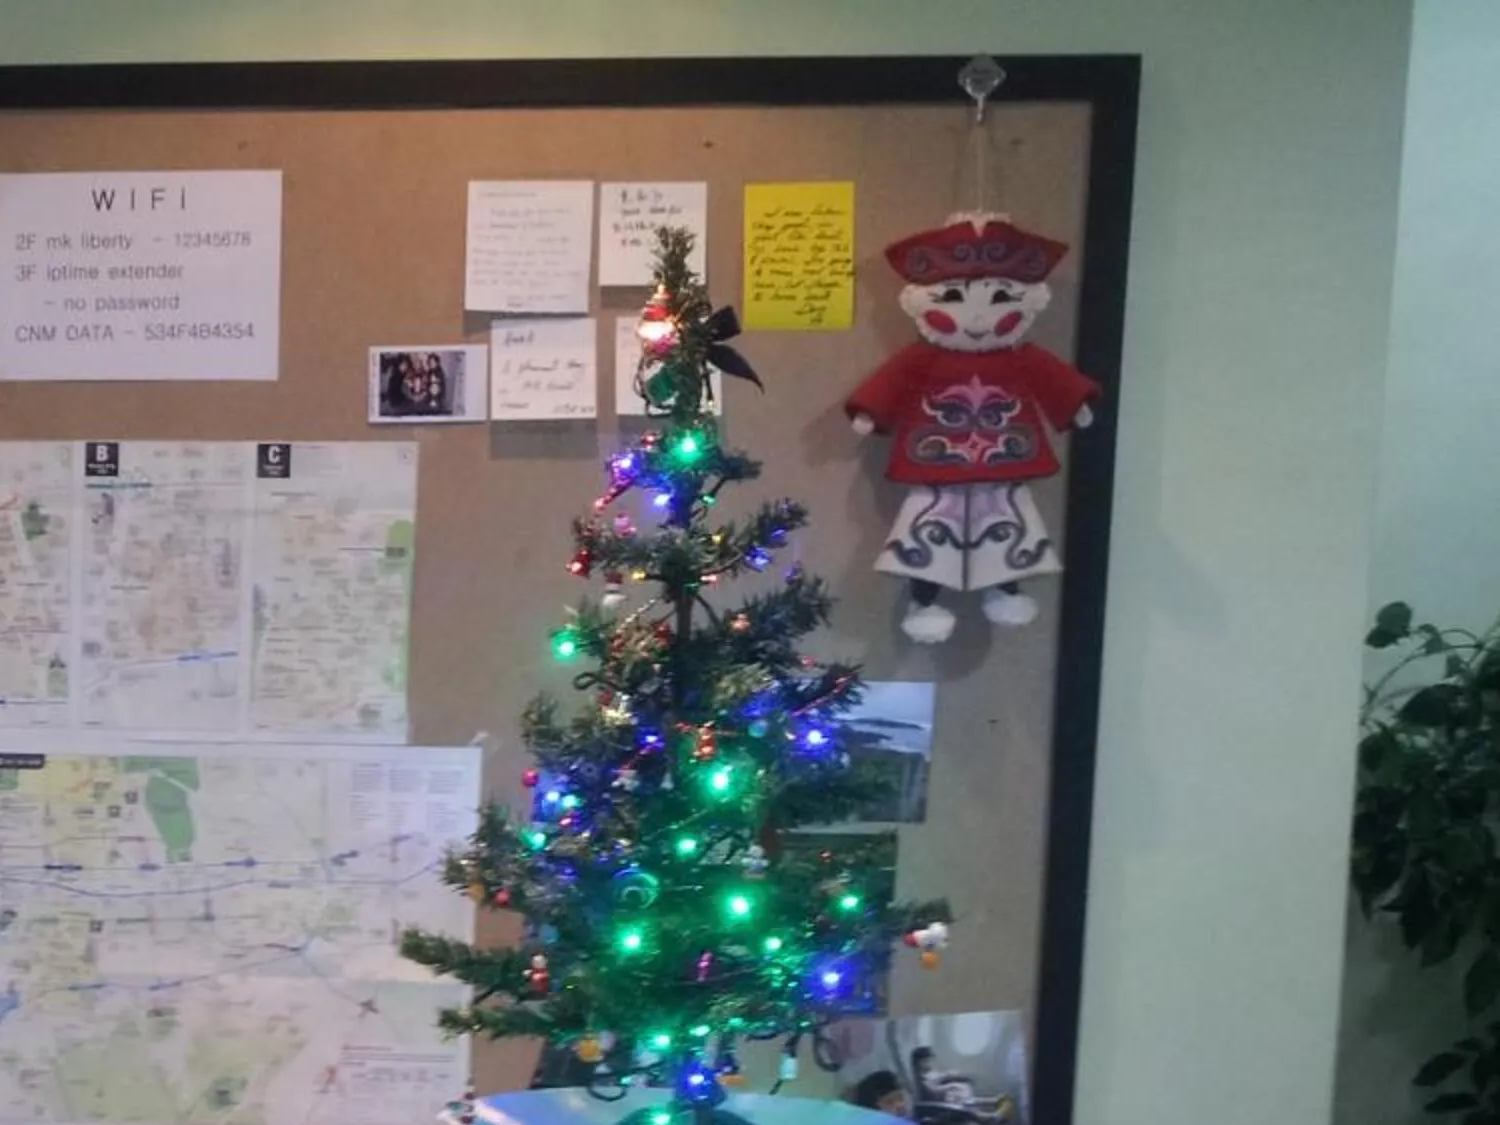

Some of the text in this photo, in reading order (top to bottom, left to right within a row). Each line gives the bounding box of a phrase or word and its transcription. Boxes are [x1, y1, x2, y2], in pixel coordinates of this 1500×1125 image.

[14, 233, 36, 251] 2F
[46, 233, 72, 249] mk
[81, 230, 133, 252] liberty
[174, 231, 252, 248] 12345678
[14, 265, 36, 281] 3F
[108, 262, 184, 281] extender
[63, 297, 86, 311] no
[95, 294, 180, 313] password
[65, 324, 114, 341] DATA
[96, 444, 109, 462] B
[268, 445, 281, 463] C
